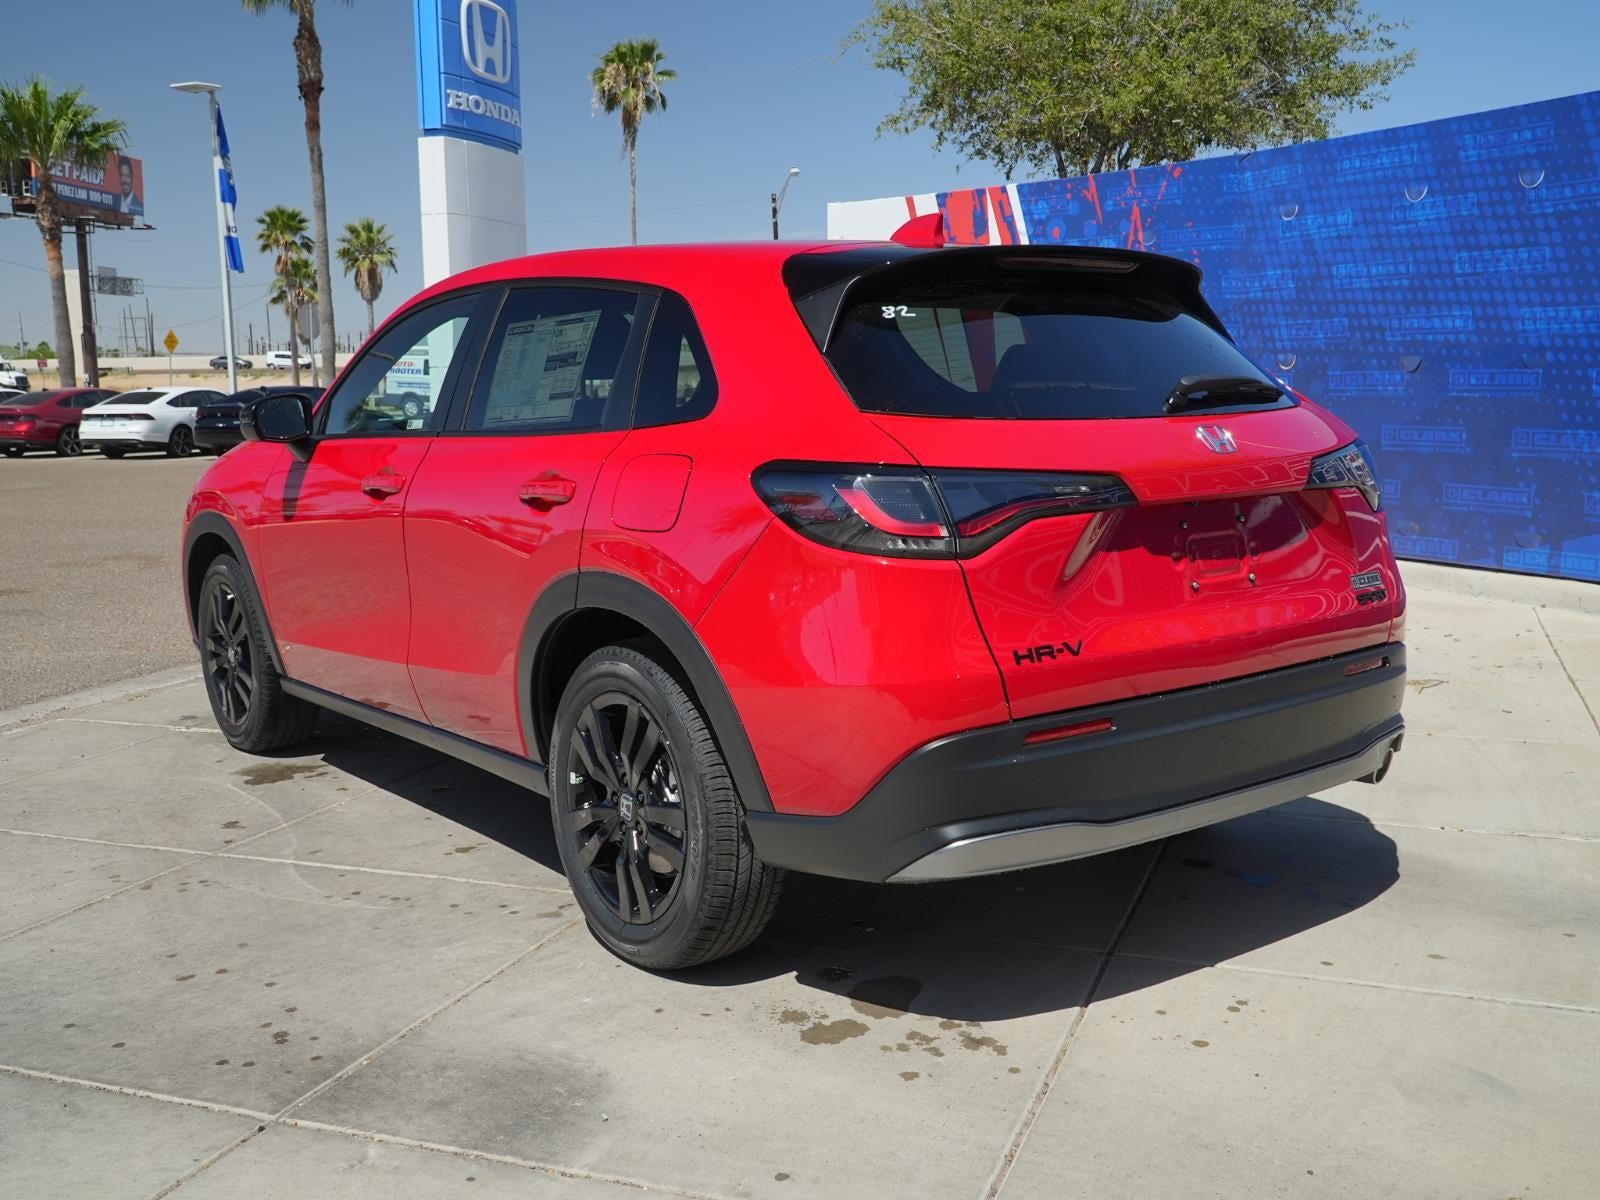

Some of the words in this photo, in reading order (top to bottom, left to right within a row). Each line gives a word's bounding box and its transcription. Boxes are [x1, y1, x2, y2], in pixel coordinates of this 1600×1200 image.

[446, 89, 520, 127] HONDA
[881, 305, 916, 319] 82
[1359, 574, 1380, 586] CLARK
[1013, 640, 1082, 666] HR-V
